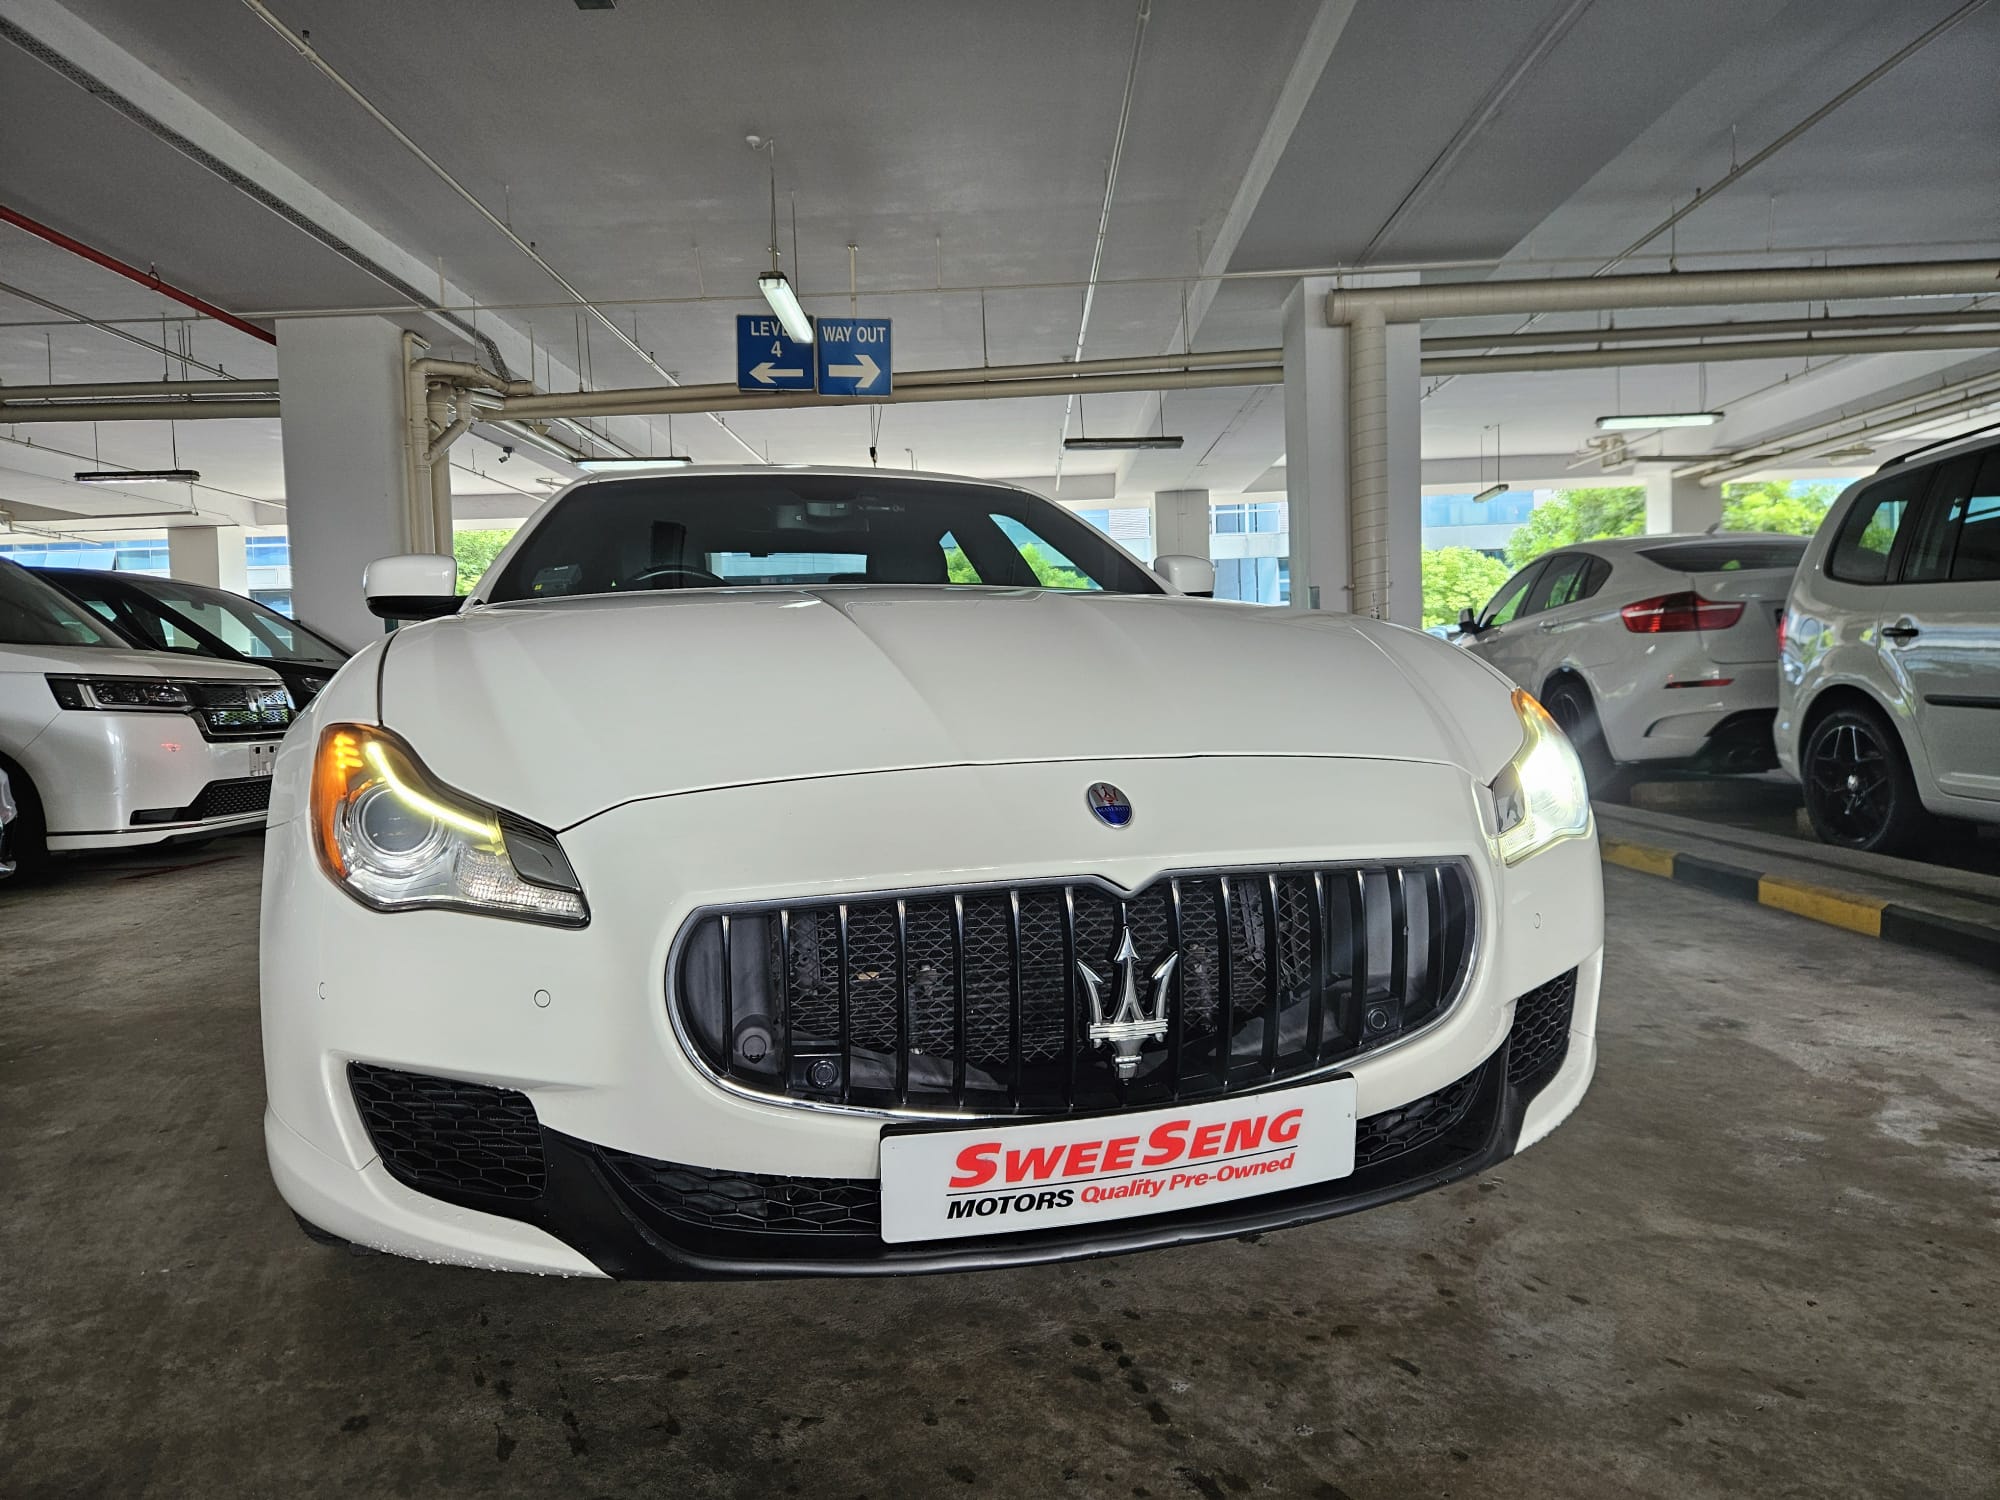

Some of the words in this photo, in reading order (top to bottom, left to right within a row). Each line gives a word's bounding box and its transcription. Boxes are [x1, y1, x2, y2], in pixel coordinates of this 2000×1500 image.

[750, 320, 790, 337] LEV
[822, 326, 853, 342] WAY
[856, 326, 886, 343] OUT
[771, 341, 783, 358] 4
[947, 1189, 1075, 1220] MOTORS
[1080, 1178, 1166, 1204] Quality
[1169, 1152, 1295, 1191] Pre-Owned
